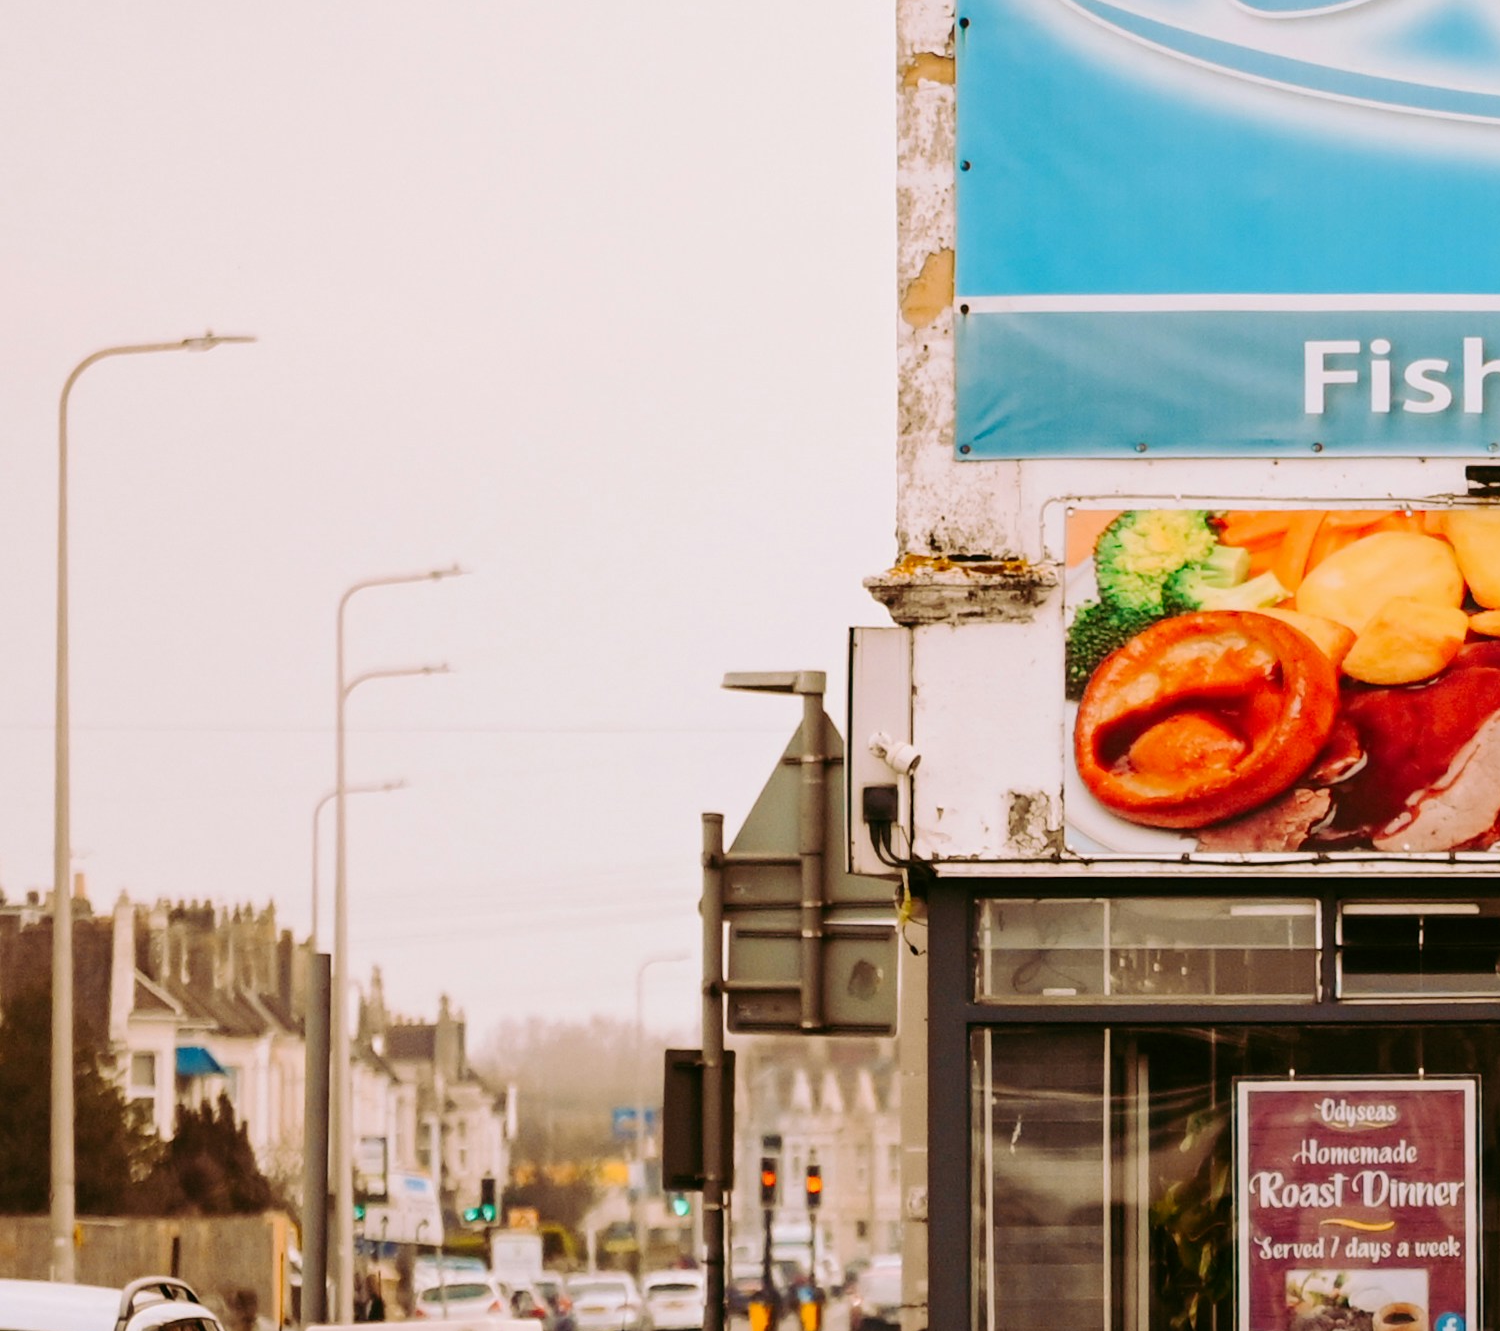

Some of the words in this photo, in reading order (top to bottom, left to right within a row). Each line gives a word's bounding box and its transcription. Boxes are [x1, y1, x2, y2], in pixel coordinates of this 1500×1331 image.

[1314, 1098, 1397, 1127] Odyseas
[1292, 1139, 1417, 1165] Homemade
[1249, 1172, 1349, 1208] Roast
[1352, 1171, 1464, 1208] Dinner
[1254, 1237, 1325, 1259] Served
[1346, 1237, 1391, 1263] days
[1397, 1244, 1409, 1257] a
[1415, 1236, 1460, 1257] week
